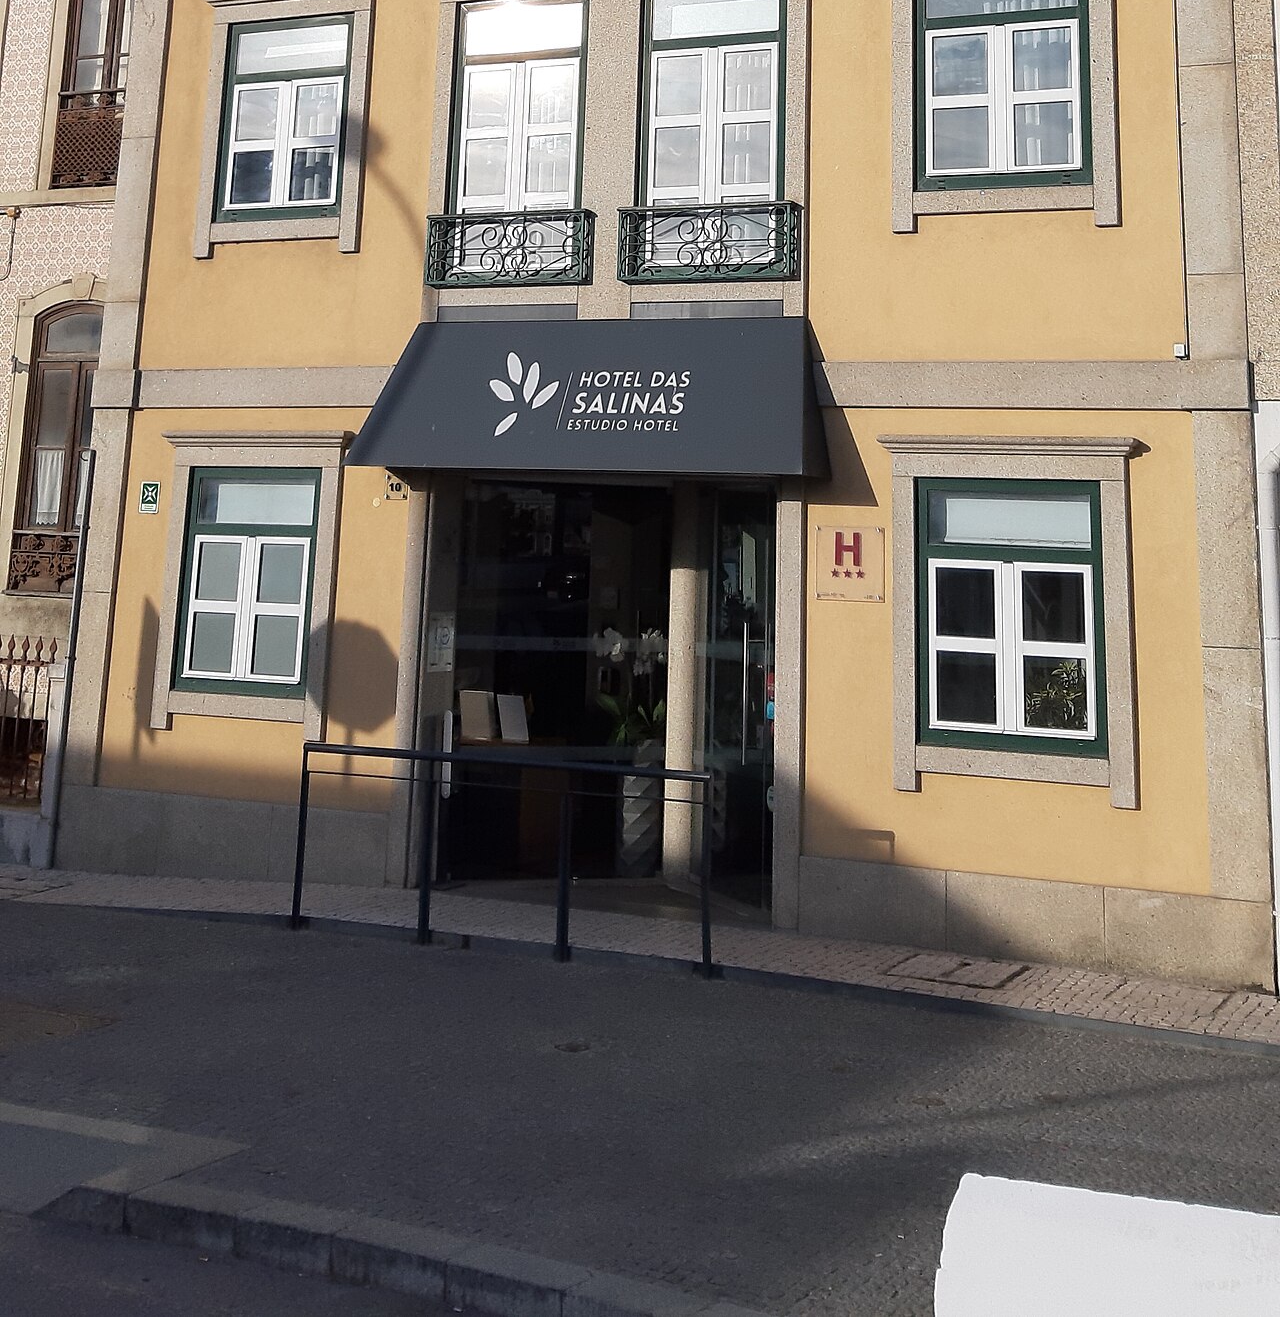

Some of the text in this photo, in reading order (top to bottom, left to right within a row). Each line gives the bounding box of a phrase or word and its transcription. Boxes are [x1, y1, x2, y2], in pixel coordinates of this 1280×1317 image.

[579, 371, 691, 388] HOTEL DAS
[572, 392, 685, 415] SALINAS
[567, 419, 679, 432] ESTUDIO HOTEL
[389, 482, 402, 492] 10
[835, 531, 862, 567] H
